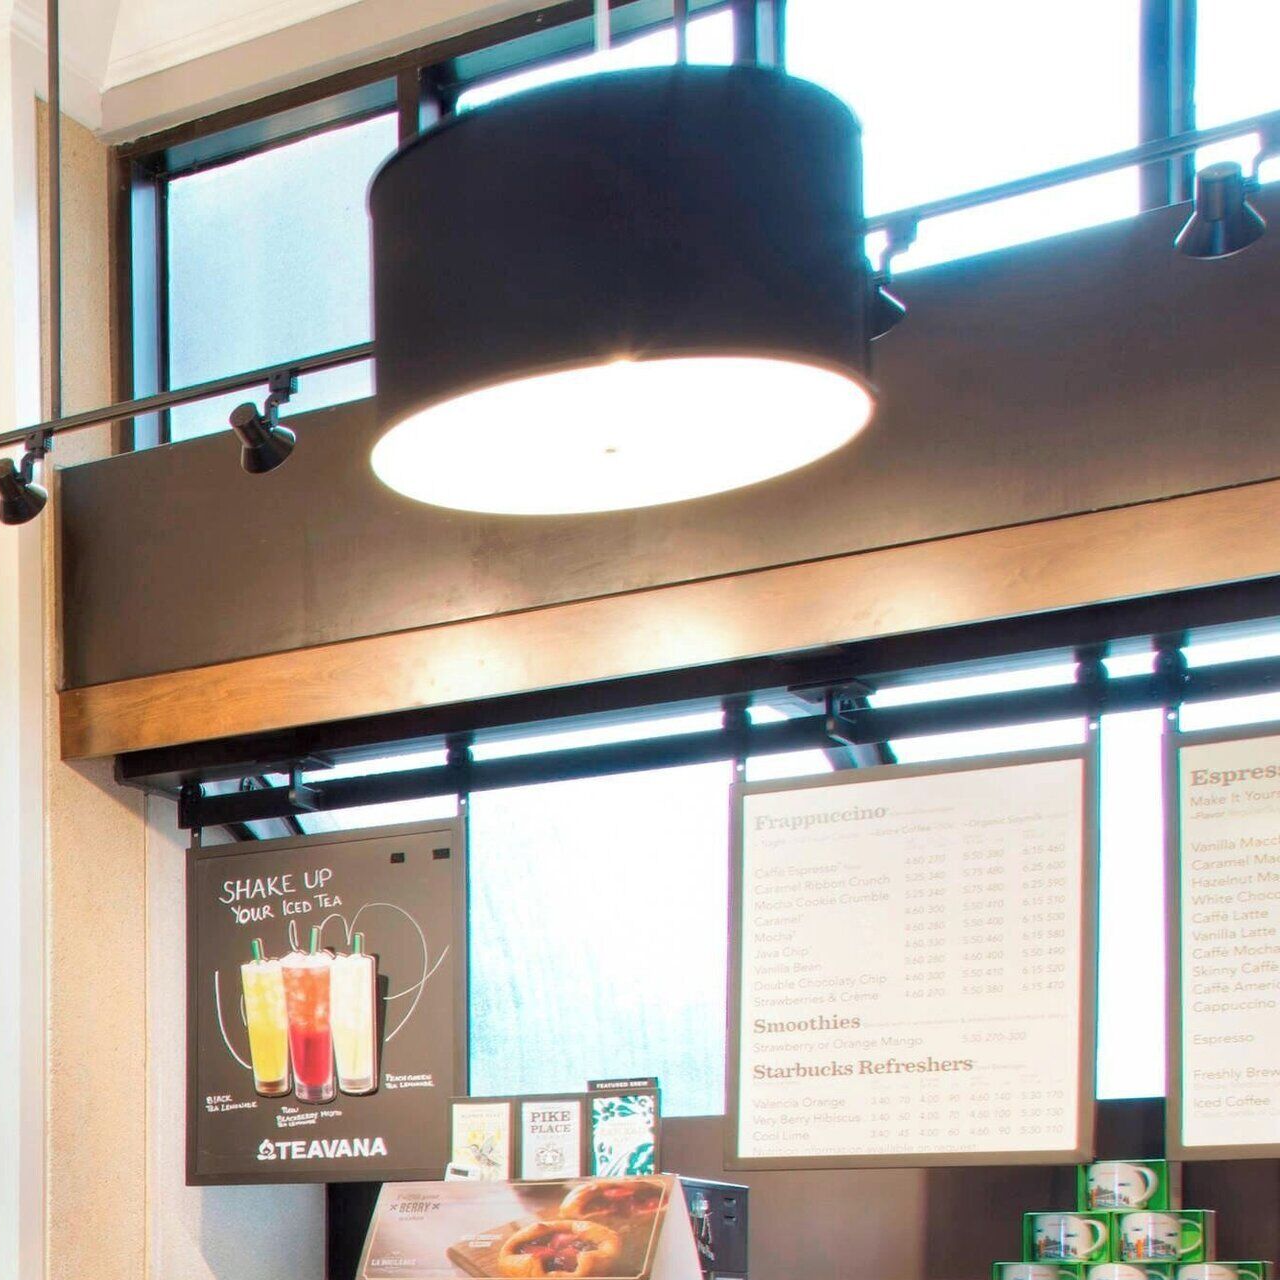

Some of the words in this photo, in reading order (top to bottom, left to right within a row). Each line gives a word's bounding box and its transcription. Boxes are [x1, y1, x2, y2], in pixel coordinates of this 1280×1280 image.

[754, 806, 889, 831] Frappuccino
[1191, 840, 1236, 853] Vanilla
[1192, 856, 1248, 871] Caramel
[219, 874, 296, 904] SHAKE
[304, 868, 332, 888] UP
[1192, 876, 1252, 888] Hazelnut
[1192, 894, 1233, 905] White
[231, 905, 274, 924] YOUR
[282, 900, 312, 916] ICED
[313, 893, 342, 908] TEA
[1233, 909, 1269, 920] Latte
[1192, 929, 1236, 941] Vanilla
[1240, 926, 1276, 938] Latte
[1193, 965, 1237, 978] Skinny
[1193, 999, 1276, 1013] Cappuccino
[753, 1014, 861, 1034] Smoothies
[754, 1042, 814, 1053] Strawberry
[818, 1041, 830, 1050] or
[833, 1038, 878, 1050] Orange
[881, 1036, 923, 1048] Mango
[1193, 1033, 1254, 1045] Espresso
[753, 1060, 854, 1080] Starbucks
[859, 1057, 974, 1076] Refreshers
[1194, 1067, 1240, 1081] Freshly
[596, 1081, 628, 1090] FEATURED
[802, 1096, 845, 1109] Orange
[1194, 1097, 1221, 1109] Iced
[1226, 1094, 1270, 1107] Coffee
[531, 1110, 571, 1123] PIKE
[753, 1115, 776, 1127] Very
[780, 1113, 810, 1126] Berry
[813, 1112, 861, 1123] Hibiscus
[531, 1124, 571, 1134] PLACE
[753, 1131, 779, 1141] Cool
[782, 1130, 809, 1141] Lime
[275, 1137, 388, 1160] TEAVANA
[399, 1202, 431, 1213] BERRY
